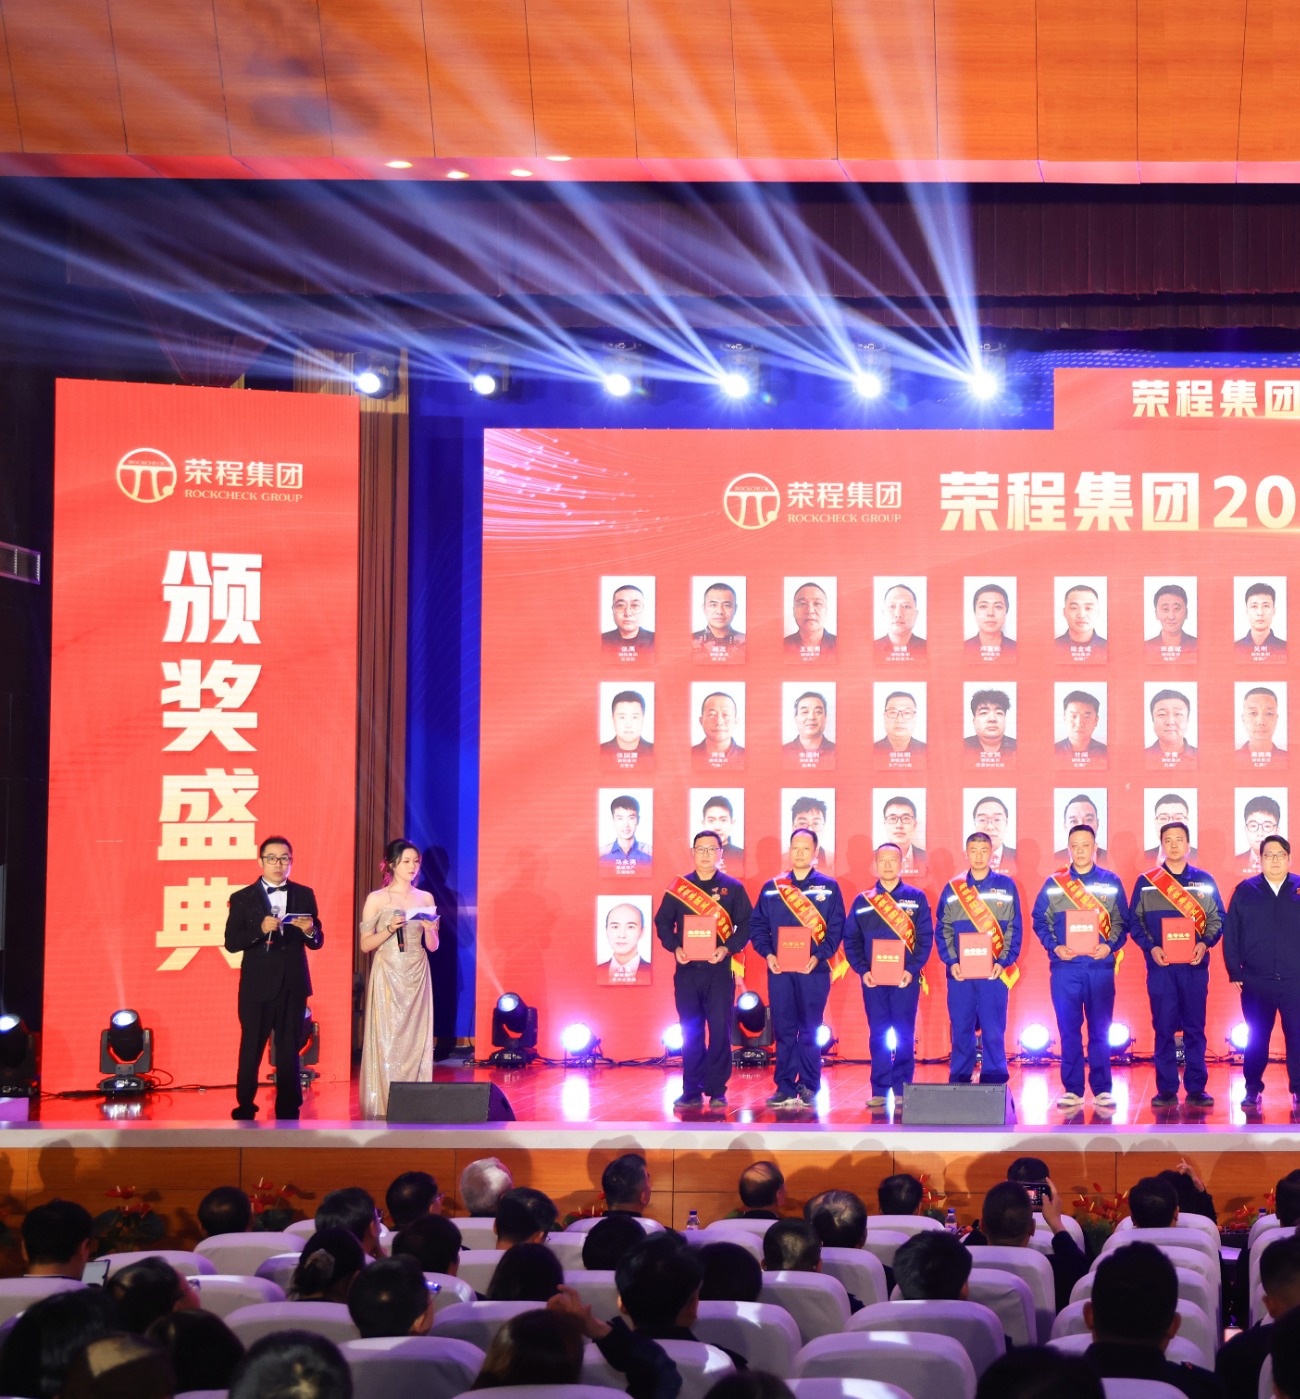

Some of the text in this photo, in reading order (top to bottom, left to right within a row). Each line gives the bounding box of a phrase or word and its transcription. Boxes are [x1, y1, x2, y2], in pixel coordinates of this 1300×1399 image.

[184, 459, 303, 489] 荣程集团
[185, 489, 303, 502] ROCKCHECK GROUP
[787, 481, 902, 509] 荣程集团
[788, 513, 902, 523] ROCKCHECK GROUP
[155, 550, 262, 971] 颁奖盛典
